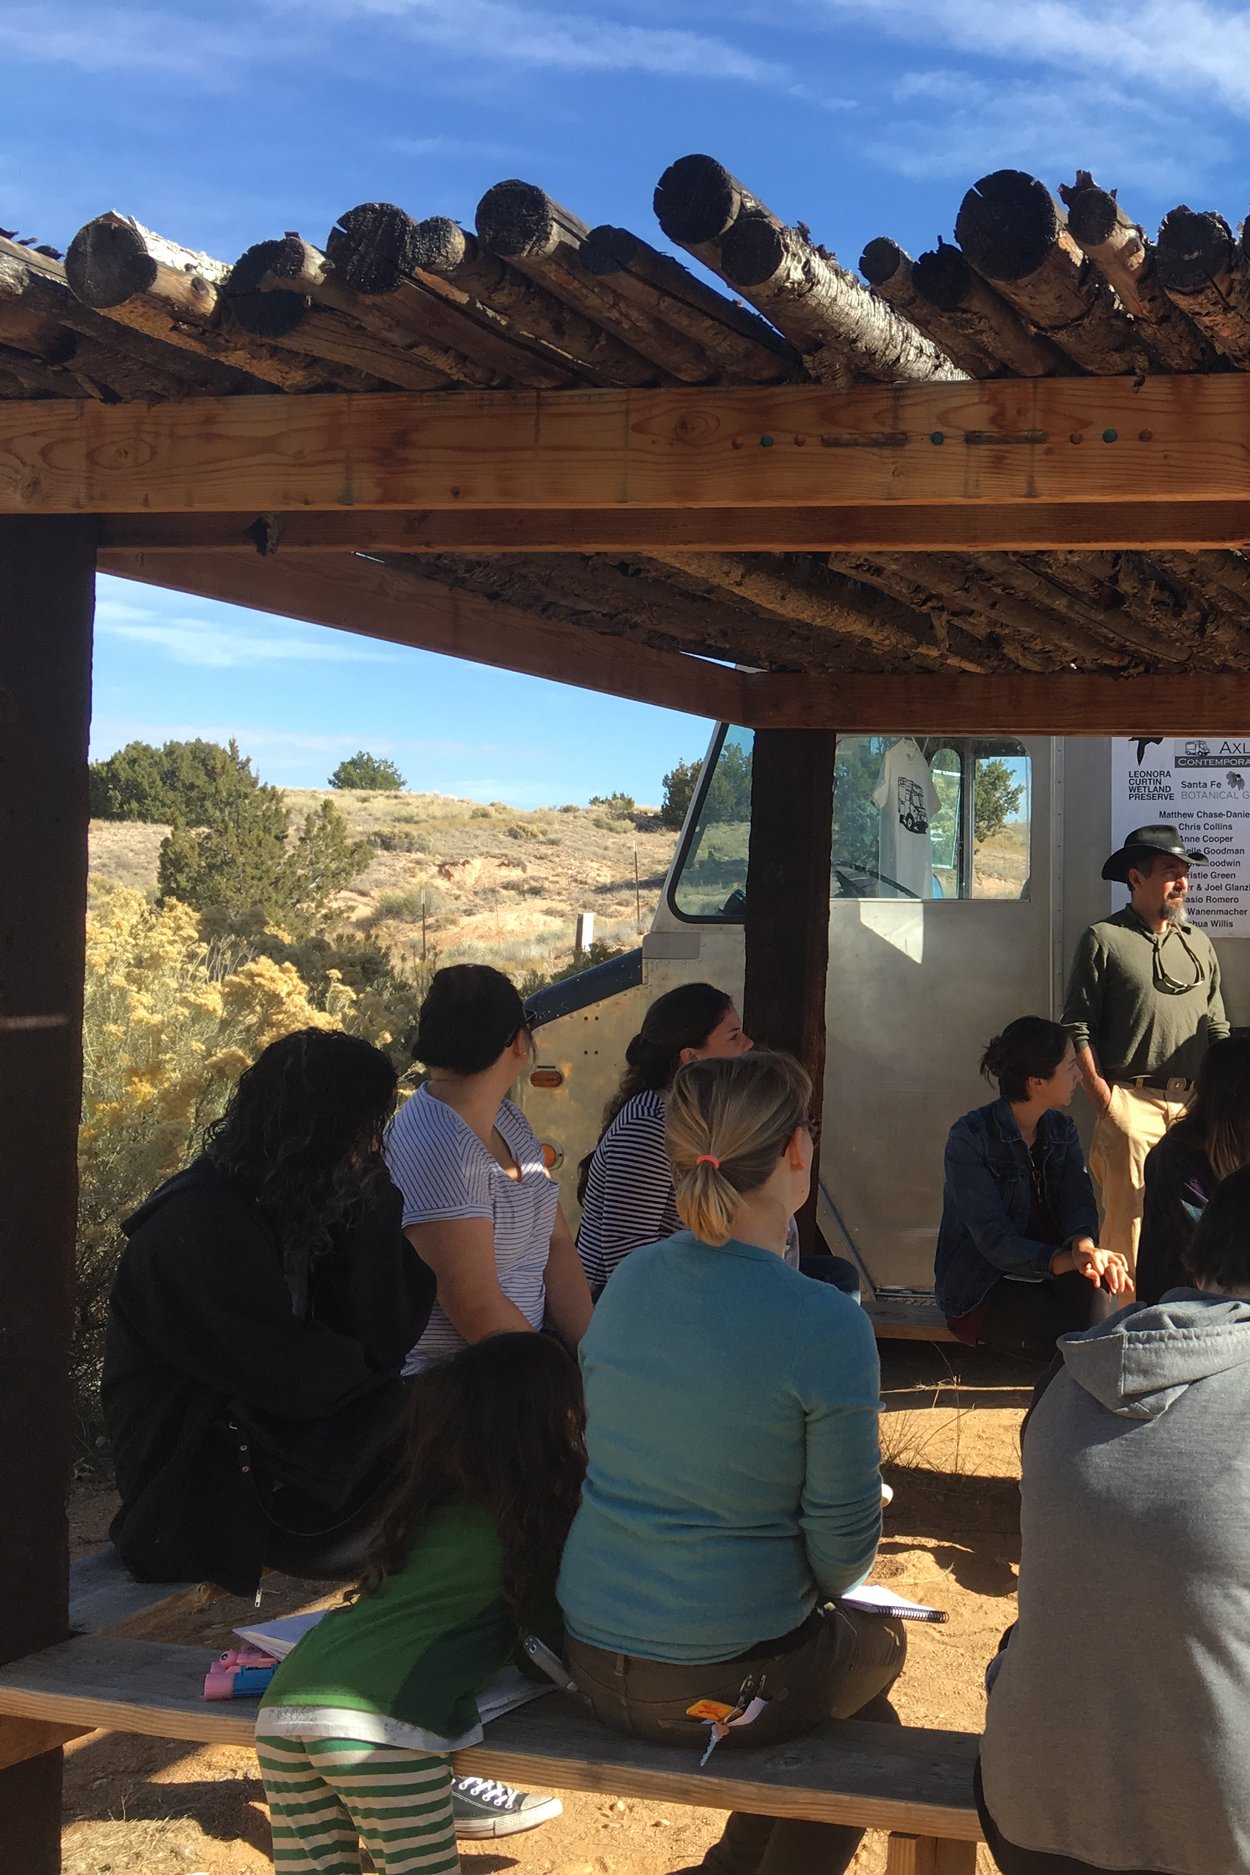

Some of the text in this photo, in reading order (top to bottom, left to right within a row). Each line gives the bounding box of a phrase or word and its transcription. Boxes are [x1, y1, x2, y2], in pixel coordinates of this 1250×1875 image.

[1128, 770, 1172, 778] LEONORA
[1128, 778, 1162, 786] CURTIN
[1181, 780, 1222, 789] Santa Fe
[1128, 793, 1175, 801] PRESERVE
[1181, 790, 1239, 800] BOTANICAL
[1159, 810, 1195, 819] Matthew
[1178, 823, 1233, 831] Chris Collins
[1202, 835, 1234, 844] Cooper
[1203, 847, 1245, 855] Goodman
[1209, 859, 1241, 867] oodwin
[1185, 896, 1240, 904] asio Romero
[1187, 908, 1248, 916] Wanenmacher
[1210, 920, 1234, 928] Willis
